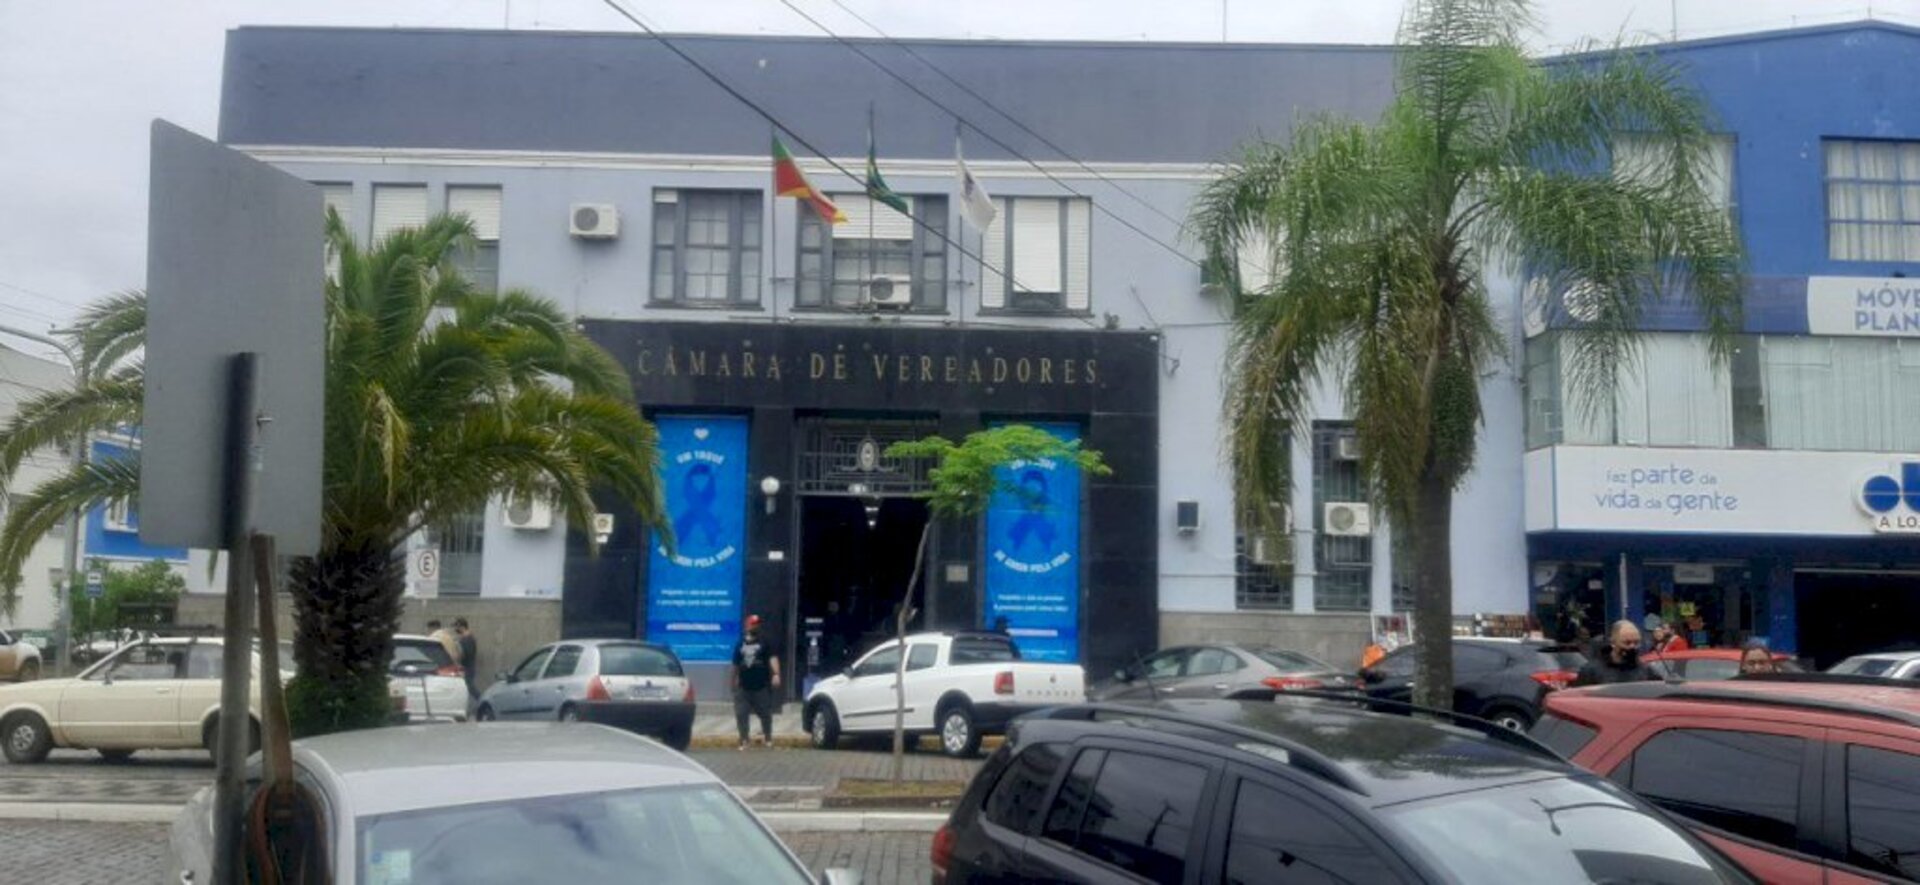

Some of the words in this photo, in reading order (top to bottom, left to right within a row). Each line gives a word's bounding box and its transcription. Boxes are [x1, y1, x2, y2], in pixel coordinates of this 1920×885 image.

[638, 346, 781, 380] CÂMARA
[810, 352, 847, 380] DE
[874, 353, 1098, 385] VEREADORES
[1631, 463, 1694, 488] parte
[1595, 488, 1640, 508] vida
[1666, 491, 1738, 516] gente
[1880, 516, 1890, 528] A
[1897, 516, 1920, 528] LO
[423, 556, 431, 572] E
